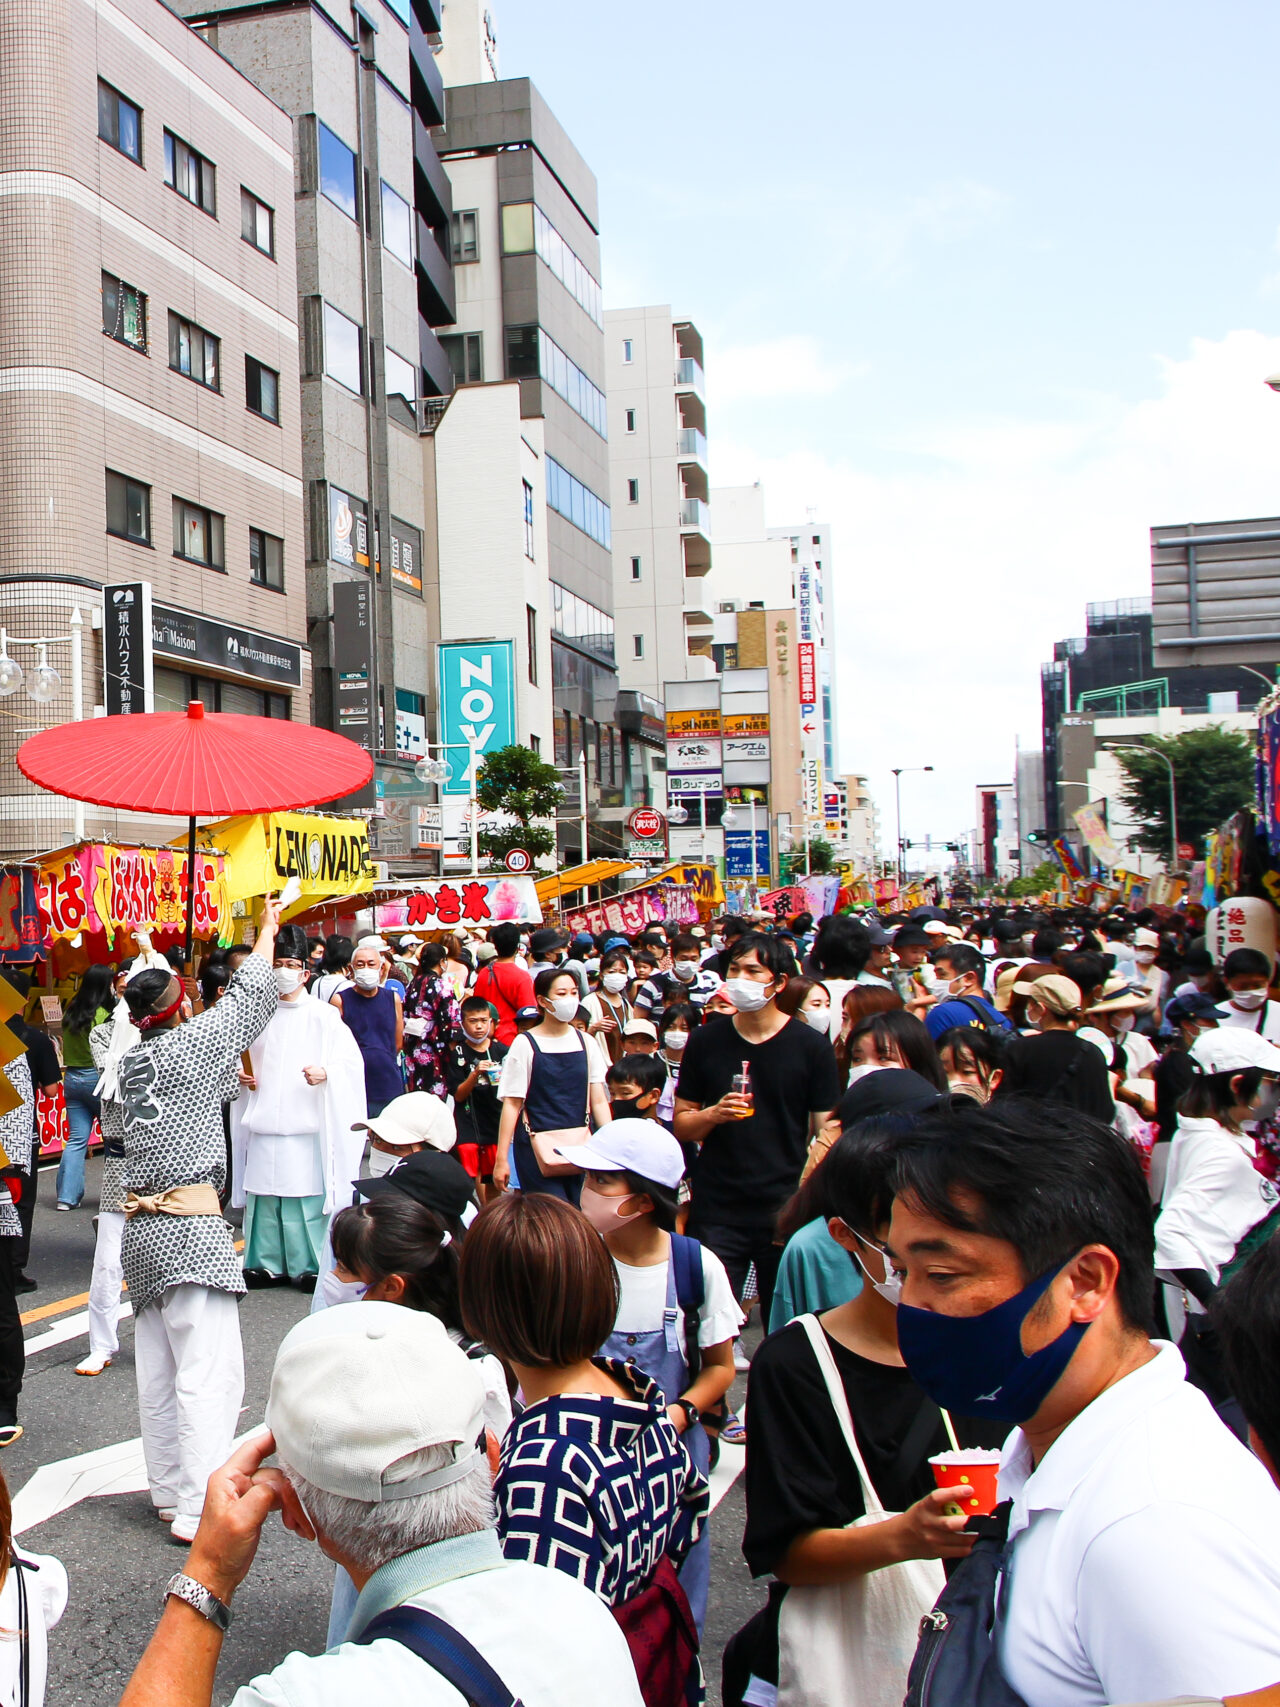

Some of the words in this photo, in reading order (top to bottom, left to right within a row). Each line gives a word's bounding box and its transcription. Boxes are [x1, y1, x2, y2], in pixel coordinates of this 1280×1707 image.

[170, 629, 196, 652] Maison
[118, 611, 132, 714] 積水ハウス不動産
[801, 703, 815, 719] P
[636, 818, 658, 829] 消火栓
[275, 826, 372, 881] LEMONADE
[511, 855, 524, 867] 40
[406, 882, 492, 926] かき氷
